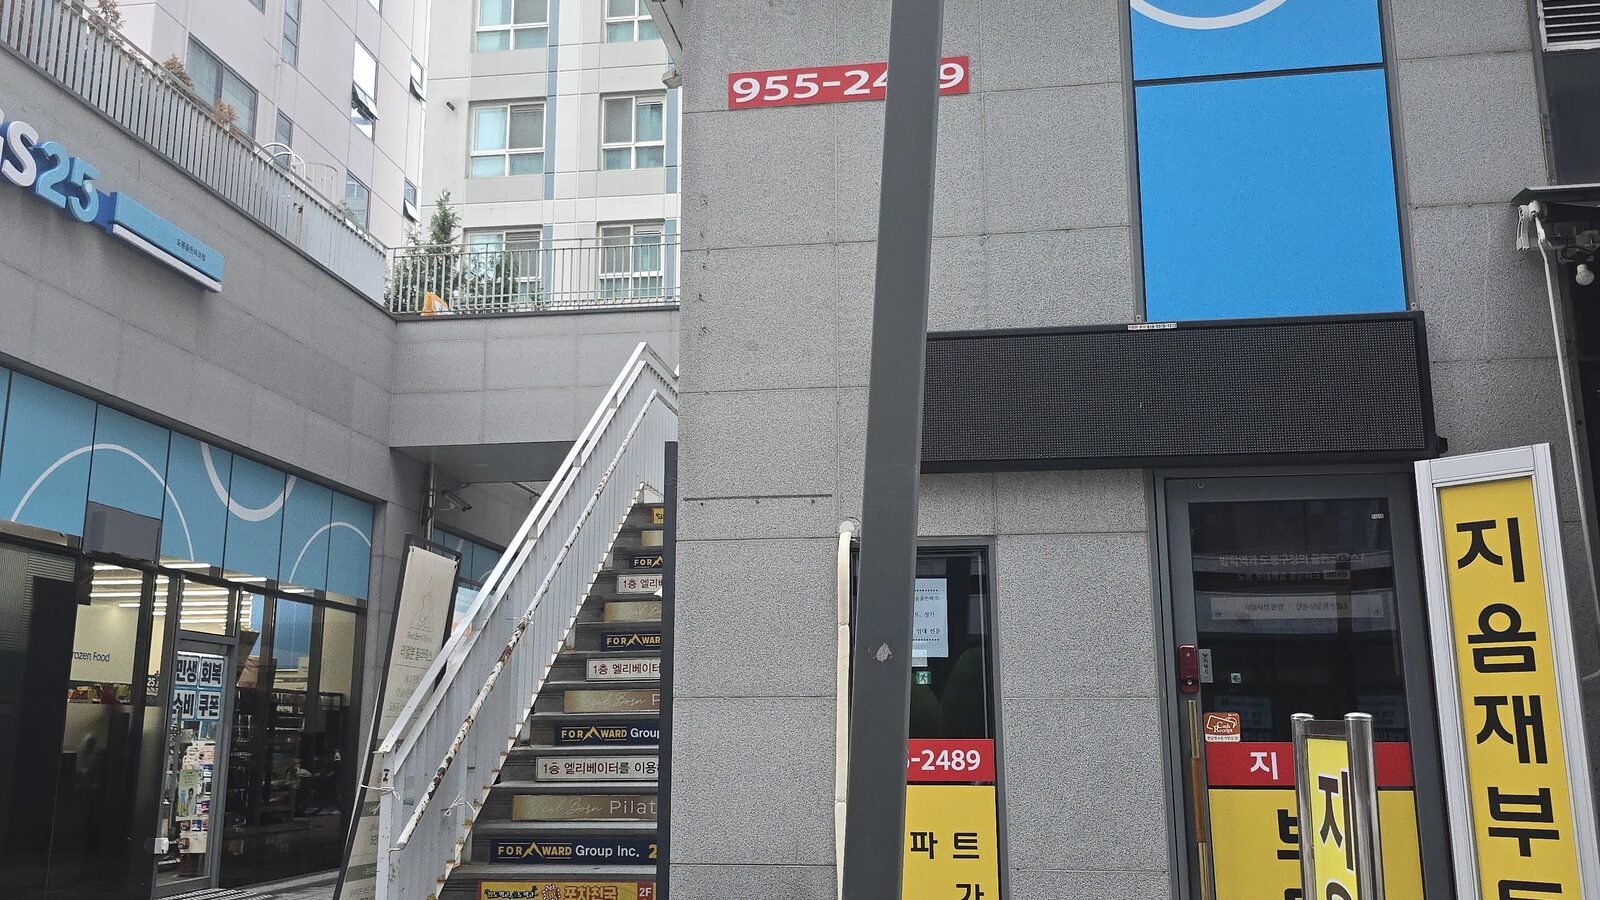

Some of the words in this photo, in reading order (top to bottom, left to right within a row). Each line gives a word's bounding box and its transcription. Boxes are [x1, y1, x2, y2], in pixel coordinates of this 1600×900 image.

[92, 652, 111, 662] Food
[176, 659, 198, 683] 민생
[200, 661, 222, 685] 회복
[593, 664, 608, 675] 1층
[198, 694, 220, 717] 쿠폰
[906, 749, 981, 771] -2489
[543, 761, 560, 775] 1층
[564, 761, 631, 776] 엘리베이터를
[575, 844, 613, 859] Group
[617, 844, 640, 858] Inc.
[638, 887, 652, 897] 2F
